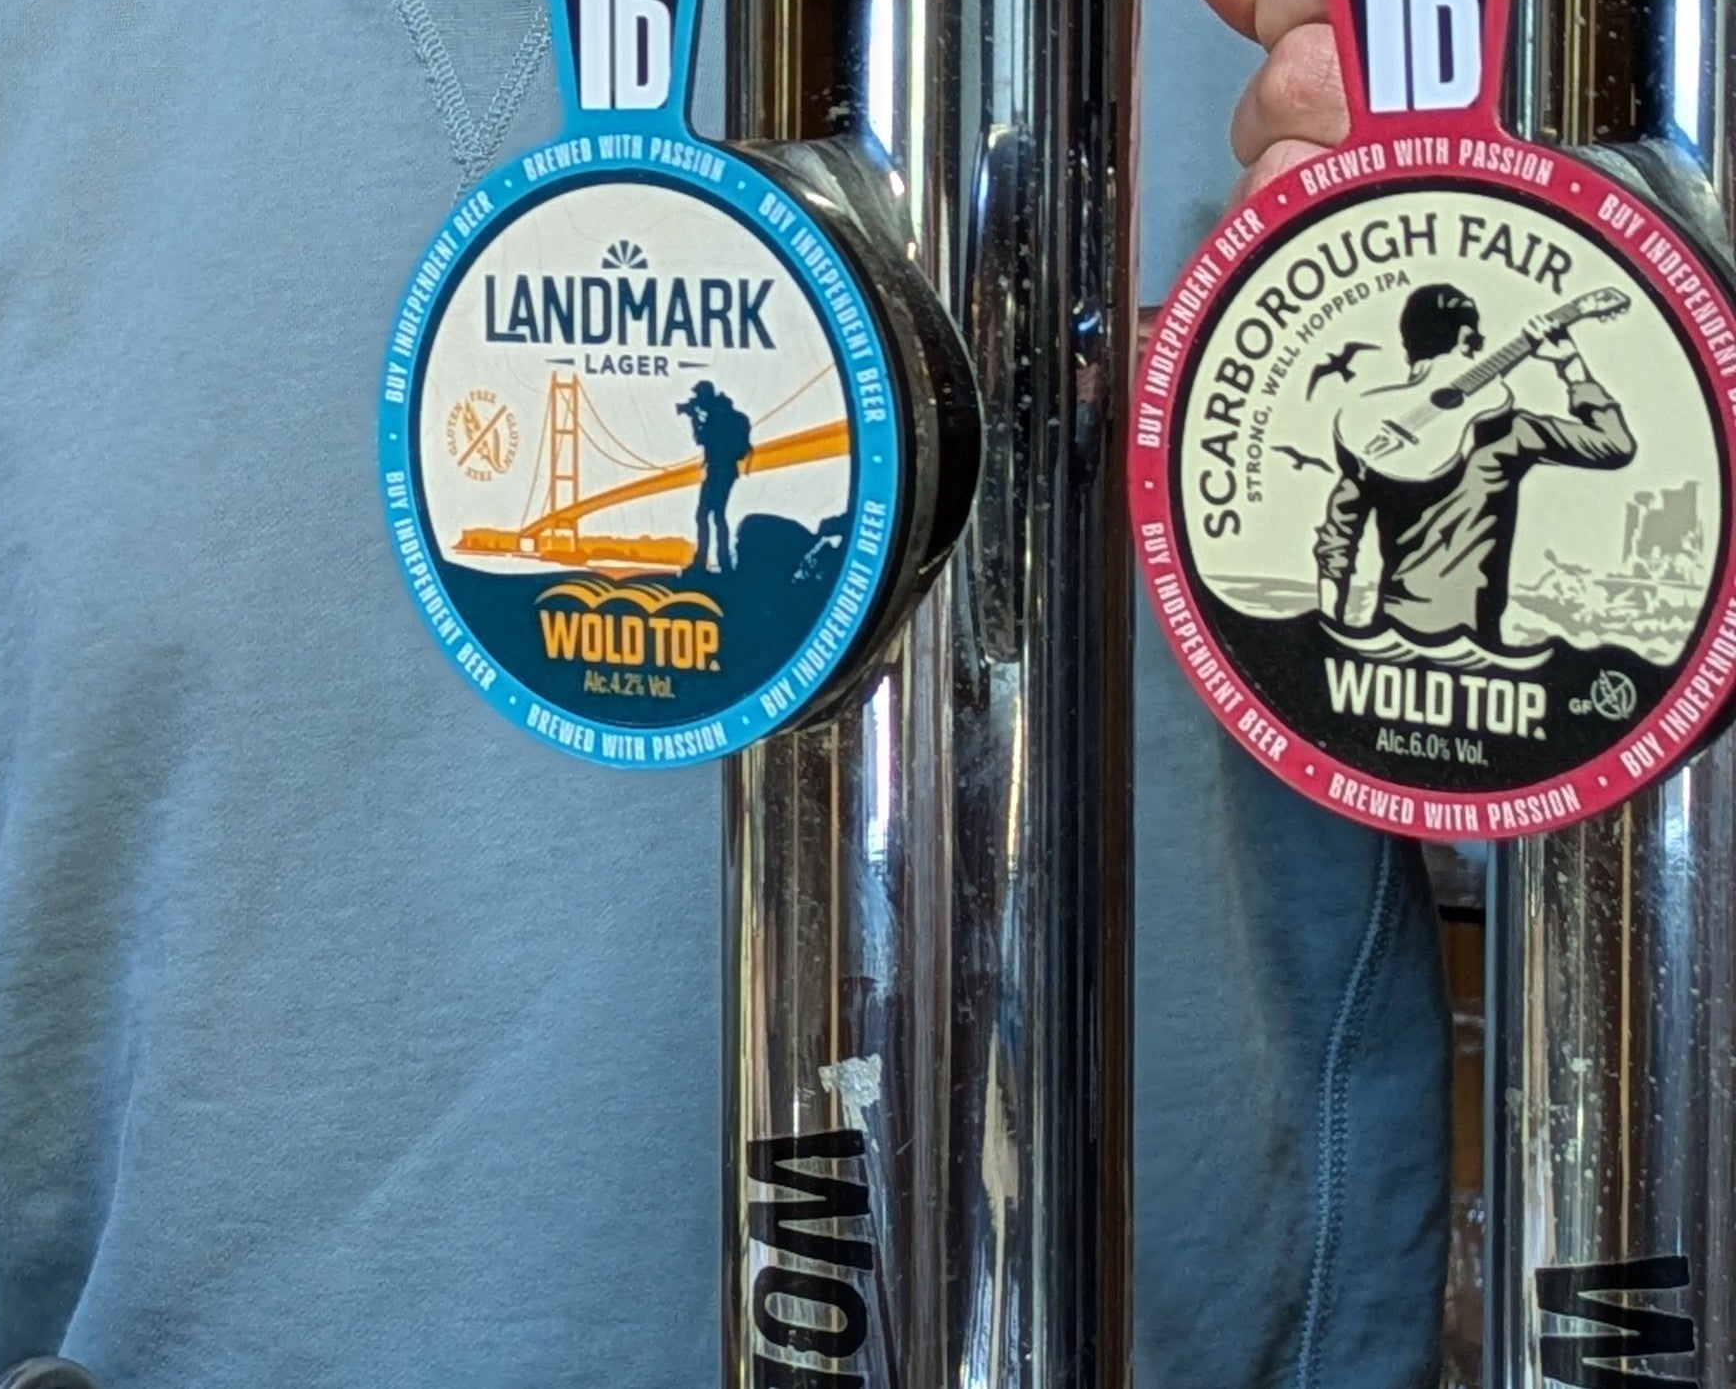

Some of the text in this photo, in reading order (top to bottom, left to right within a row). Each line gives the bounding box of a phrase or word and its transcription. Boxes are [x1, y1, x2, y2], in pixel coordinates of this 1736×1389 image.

[522, 133, 726, 183] BREWED WITH PASSION
[1299, 137, 1554, 197] BREWED WITH PASSION
[1597, 192, 1648, 239] BUY
[384, 189, 496, 404] BUY INDEPENDENT BEER
[483, 273, 777, 350] LANDMARK
[758, 191, 888, 424] BUY INDEPENDENT BEER
[1137, 207, 1266, 449] BUY INDEPENDENT BEER
[584, 353, 670, 377] LAGER
[1199, 211, 1574, 539] SCARBOROUGH FAIR
[1245, 268, 1412, 503] STRONG, WELL HOPPED IPA
[385, 470, 498, 692] BUY INDEPENDENT BEER
[759, 499, 887, 719] BUY INDEPENDENT BEER
[539, 609, 646, 667] WOLD
[1141, 522, 1289, 762] BUY INDEPENDENT BEER
[1324, 657, 1454, 727] WOLD
[1567, 697, 1593, 716] GF
[526, 702, 728, 761] BREWED WITH PASSION
[1375, 726, 1490, 768] Alc.6.0% Vol.
[1620, 731, 1665, 779] BUY
[1328, 772, 1582, 832] BREWED WITH PASSION
